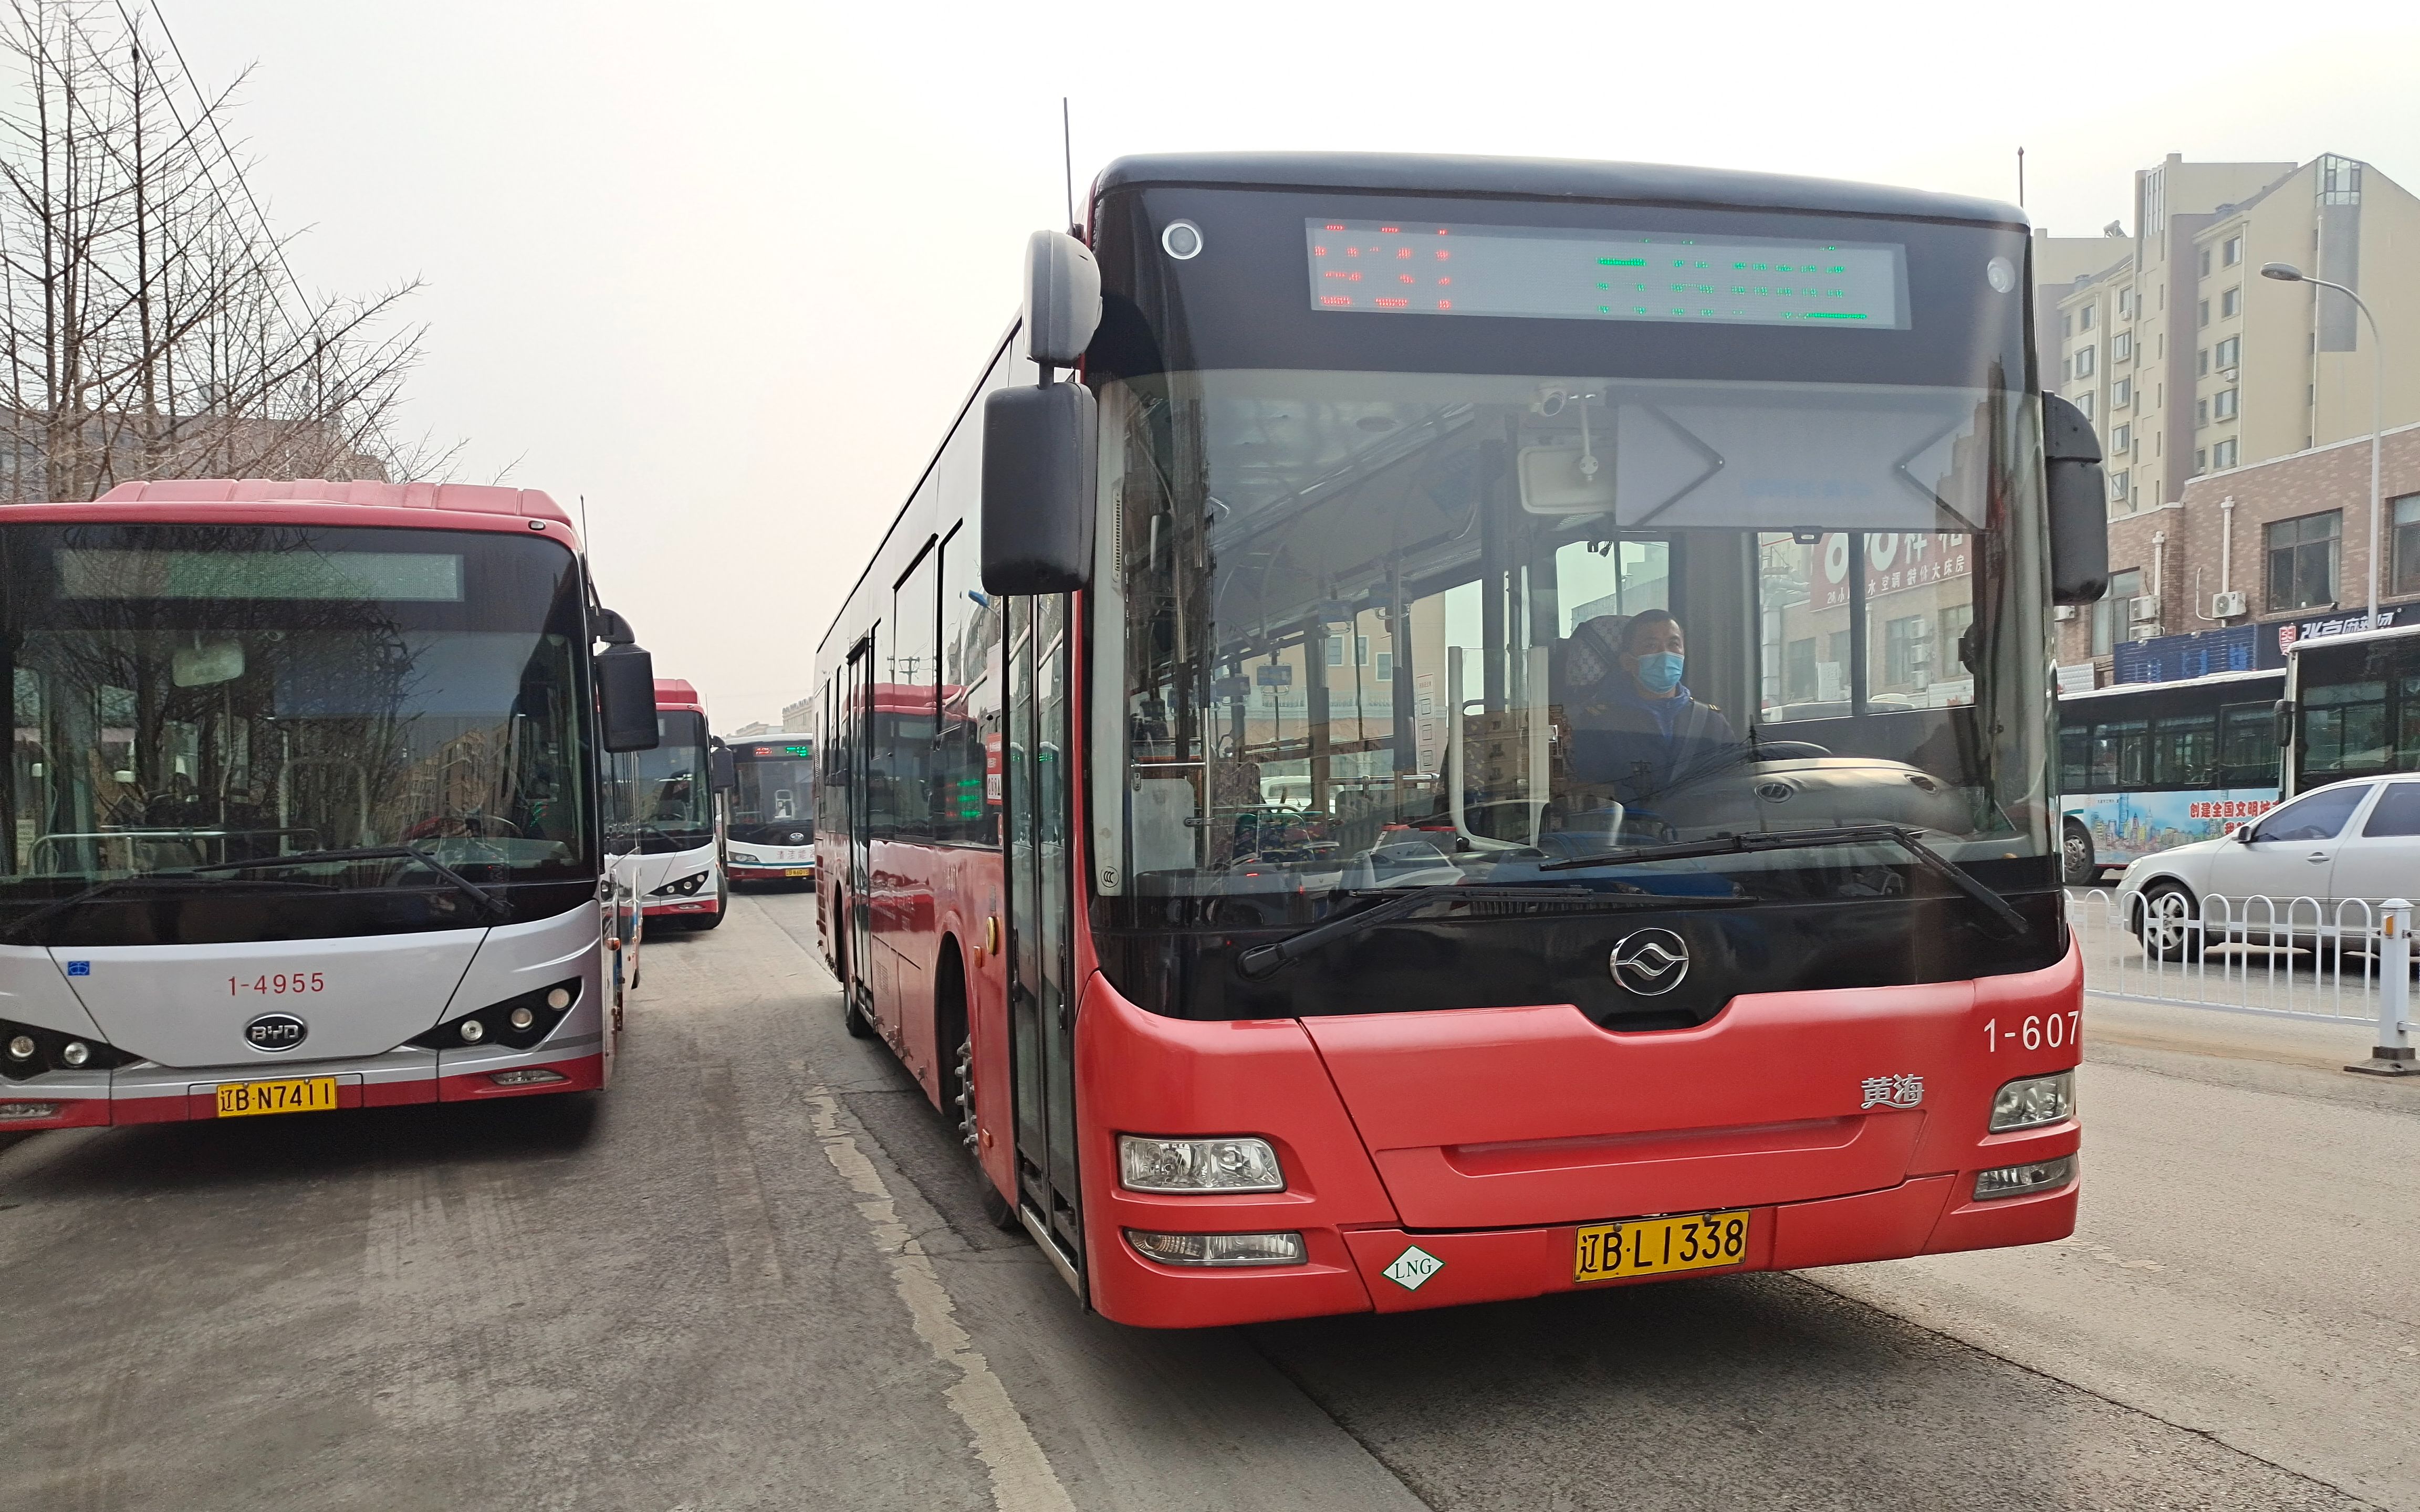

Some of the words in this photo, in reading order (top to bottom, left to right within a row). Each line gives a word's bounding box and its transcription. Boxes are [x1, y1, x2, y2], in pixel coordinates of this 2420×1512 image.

[228, 972, 324, 996] 1-4955
[252, 1024, 298, 1041] BYD
[1984, 1011, 2079, 1053] 1-607
[221, 1083, 329, 1111] 辽B·N7411
[1861, 1074, 1924, 1109] 黄海
[1580, 1219, 1744, 1273] 辽B·L1338
[1395, 1258, 1433, 1279] LNG
